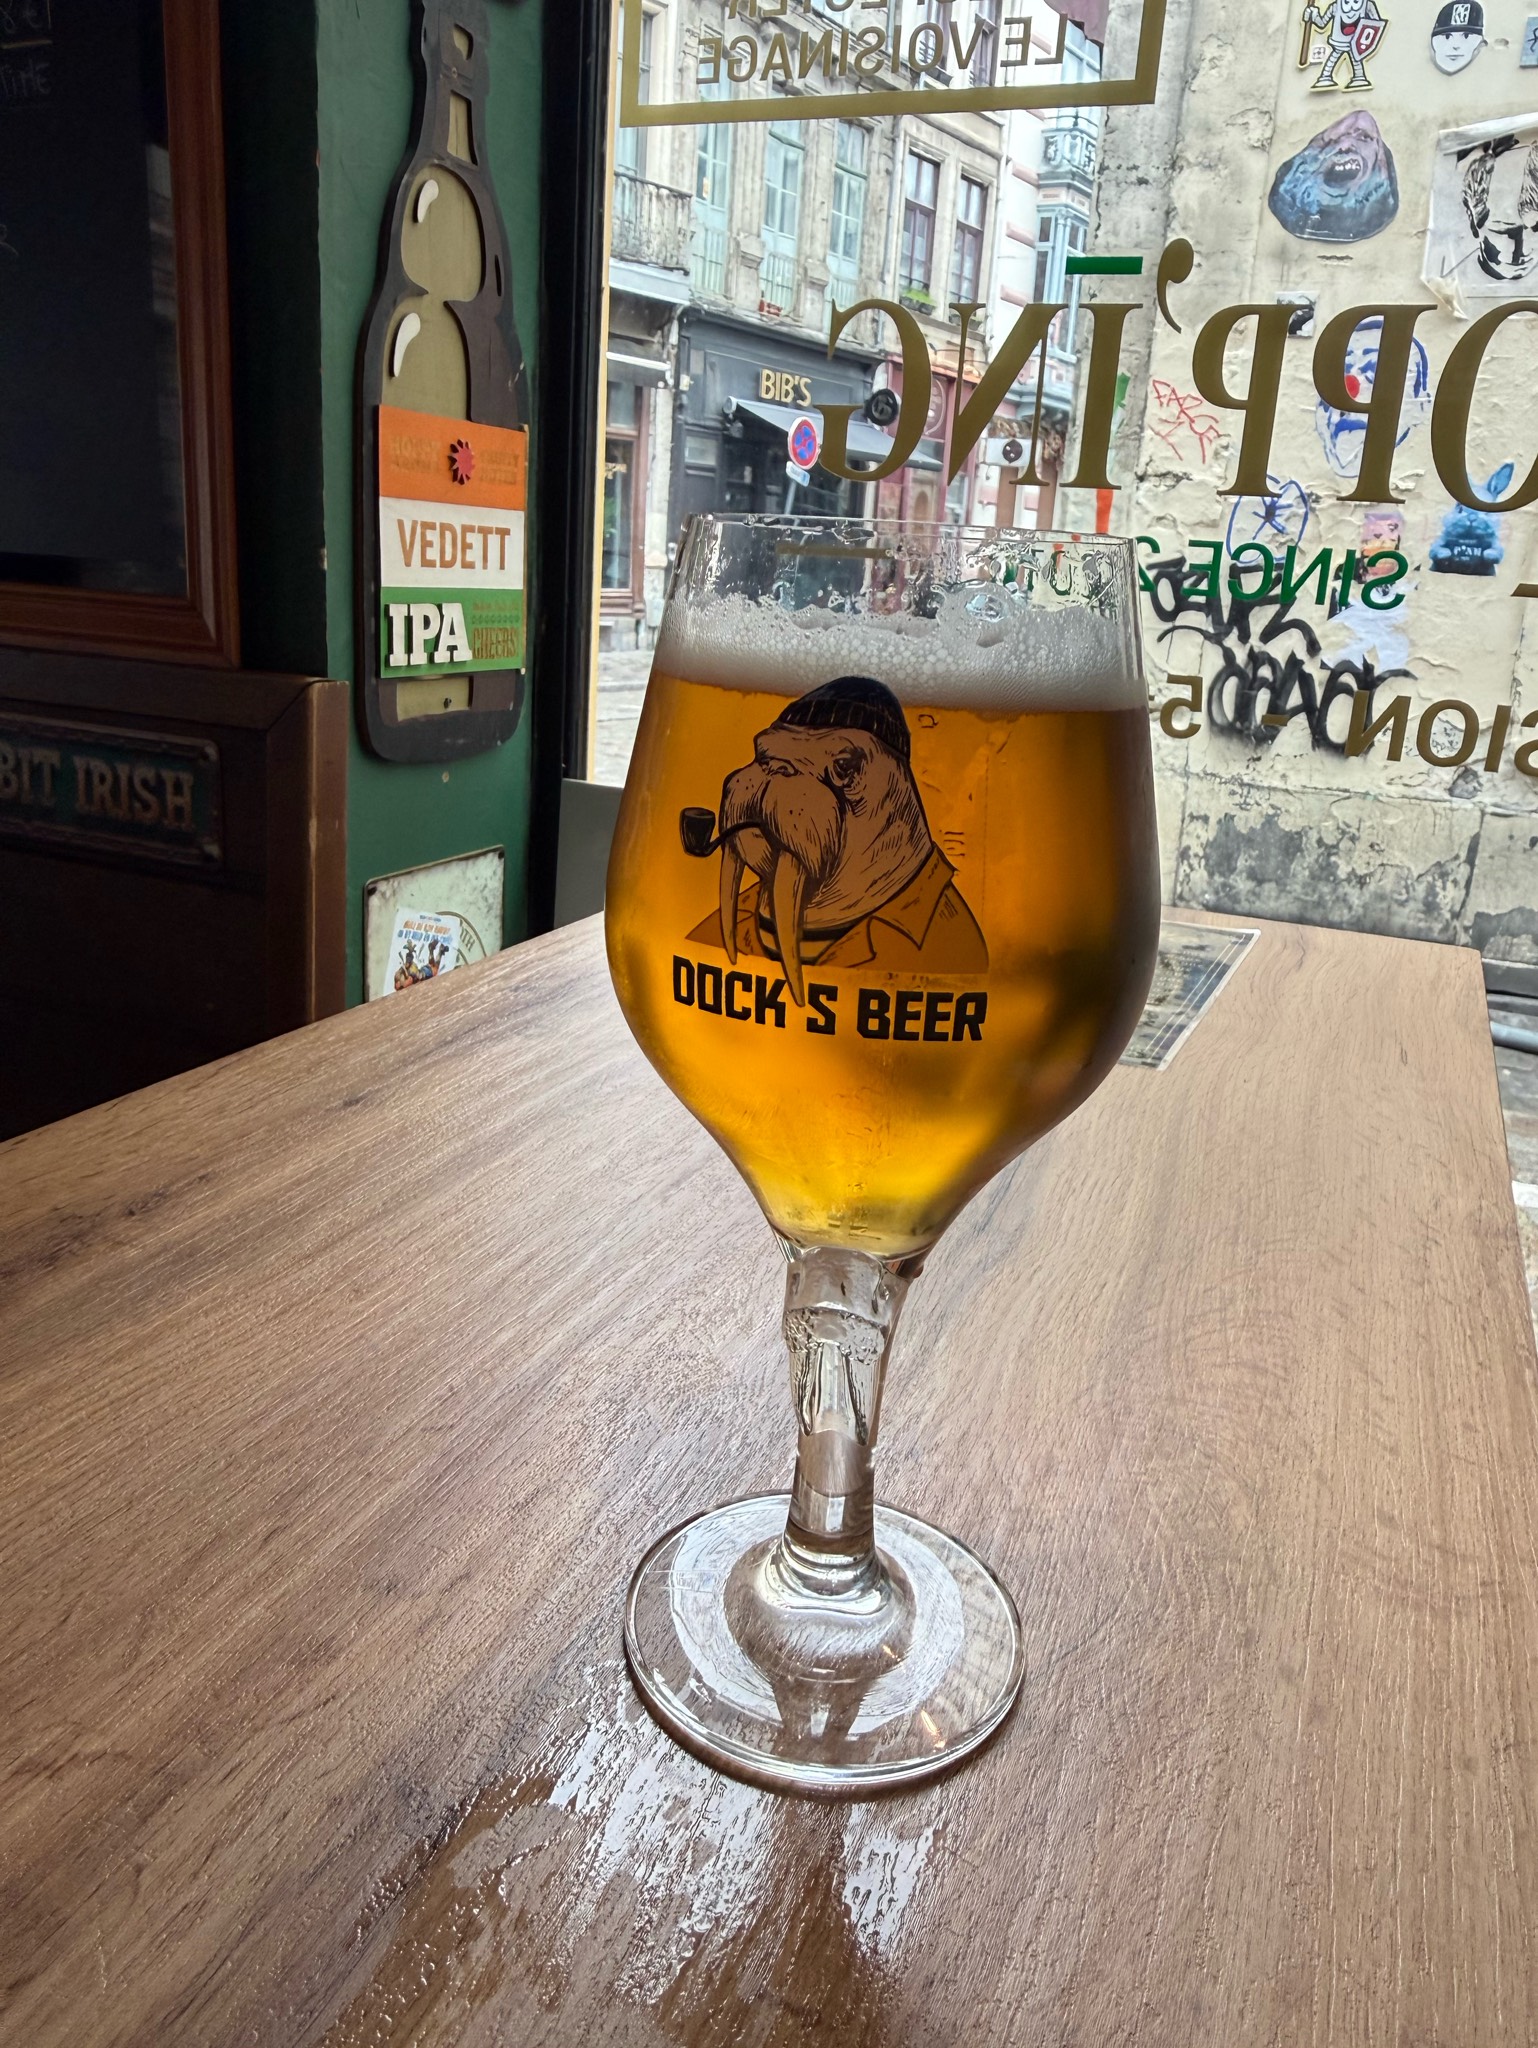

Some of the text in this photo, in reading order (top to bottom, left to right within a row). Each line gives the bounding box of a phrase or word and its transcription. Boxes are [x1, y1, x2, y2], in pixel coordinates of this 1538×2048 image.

[760, 368, 812, 407] BIB'S
[397, 518, 511, 571] VEDETT
[388, 602, 473, 668] IPA
[0, 739, 194, 832] BIT IRISH
[856, 987, 989, 1042] BEER
